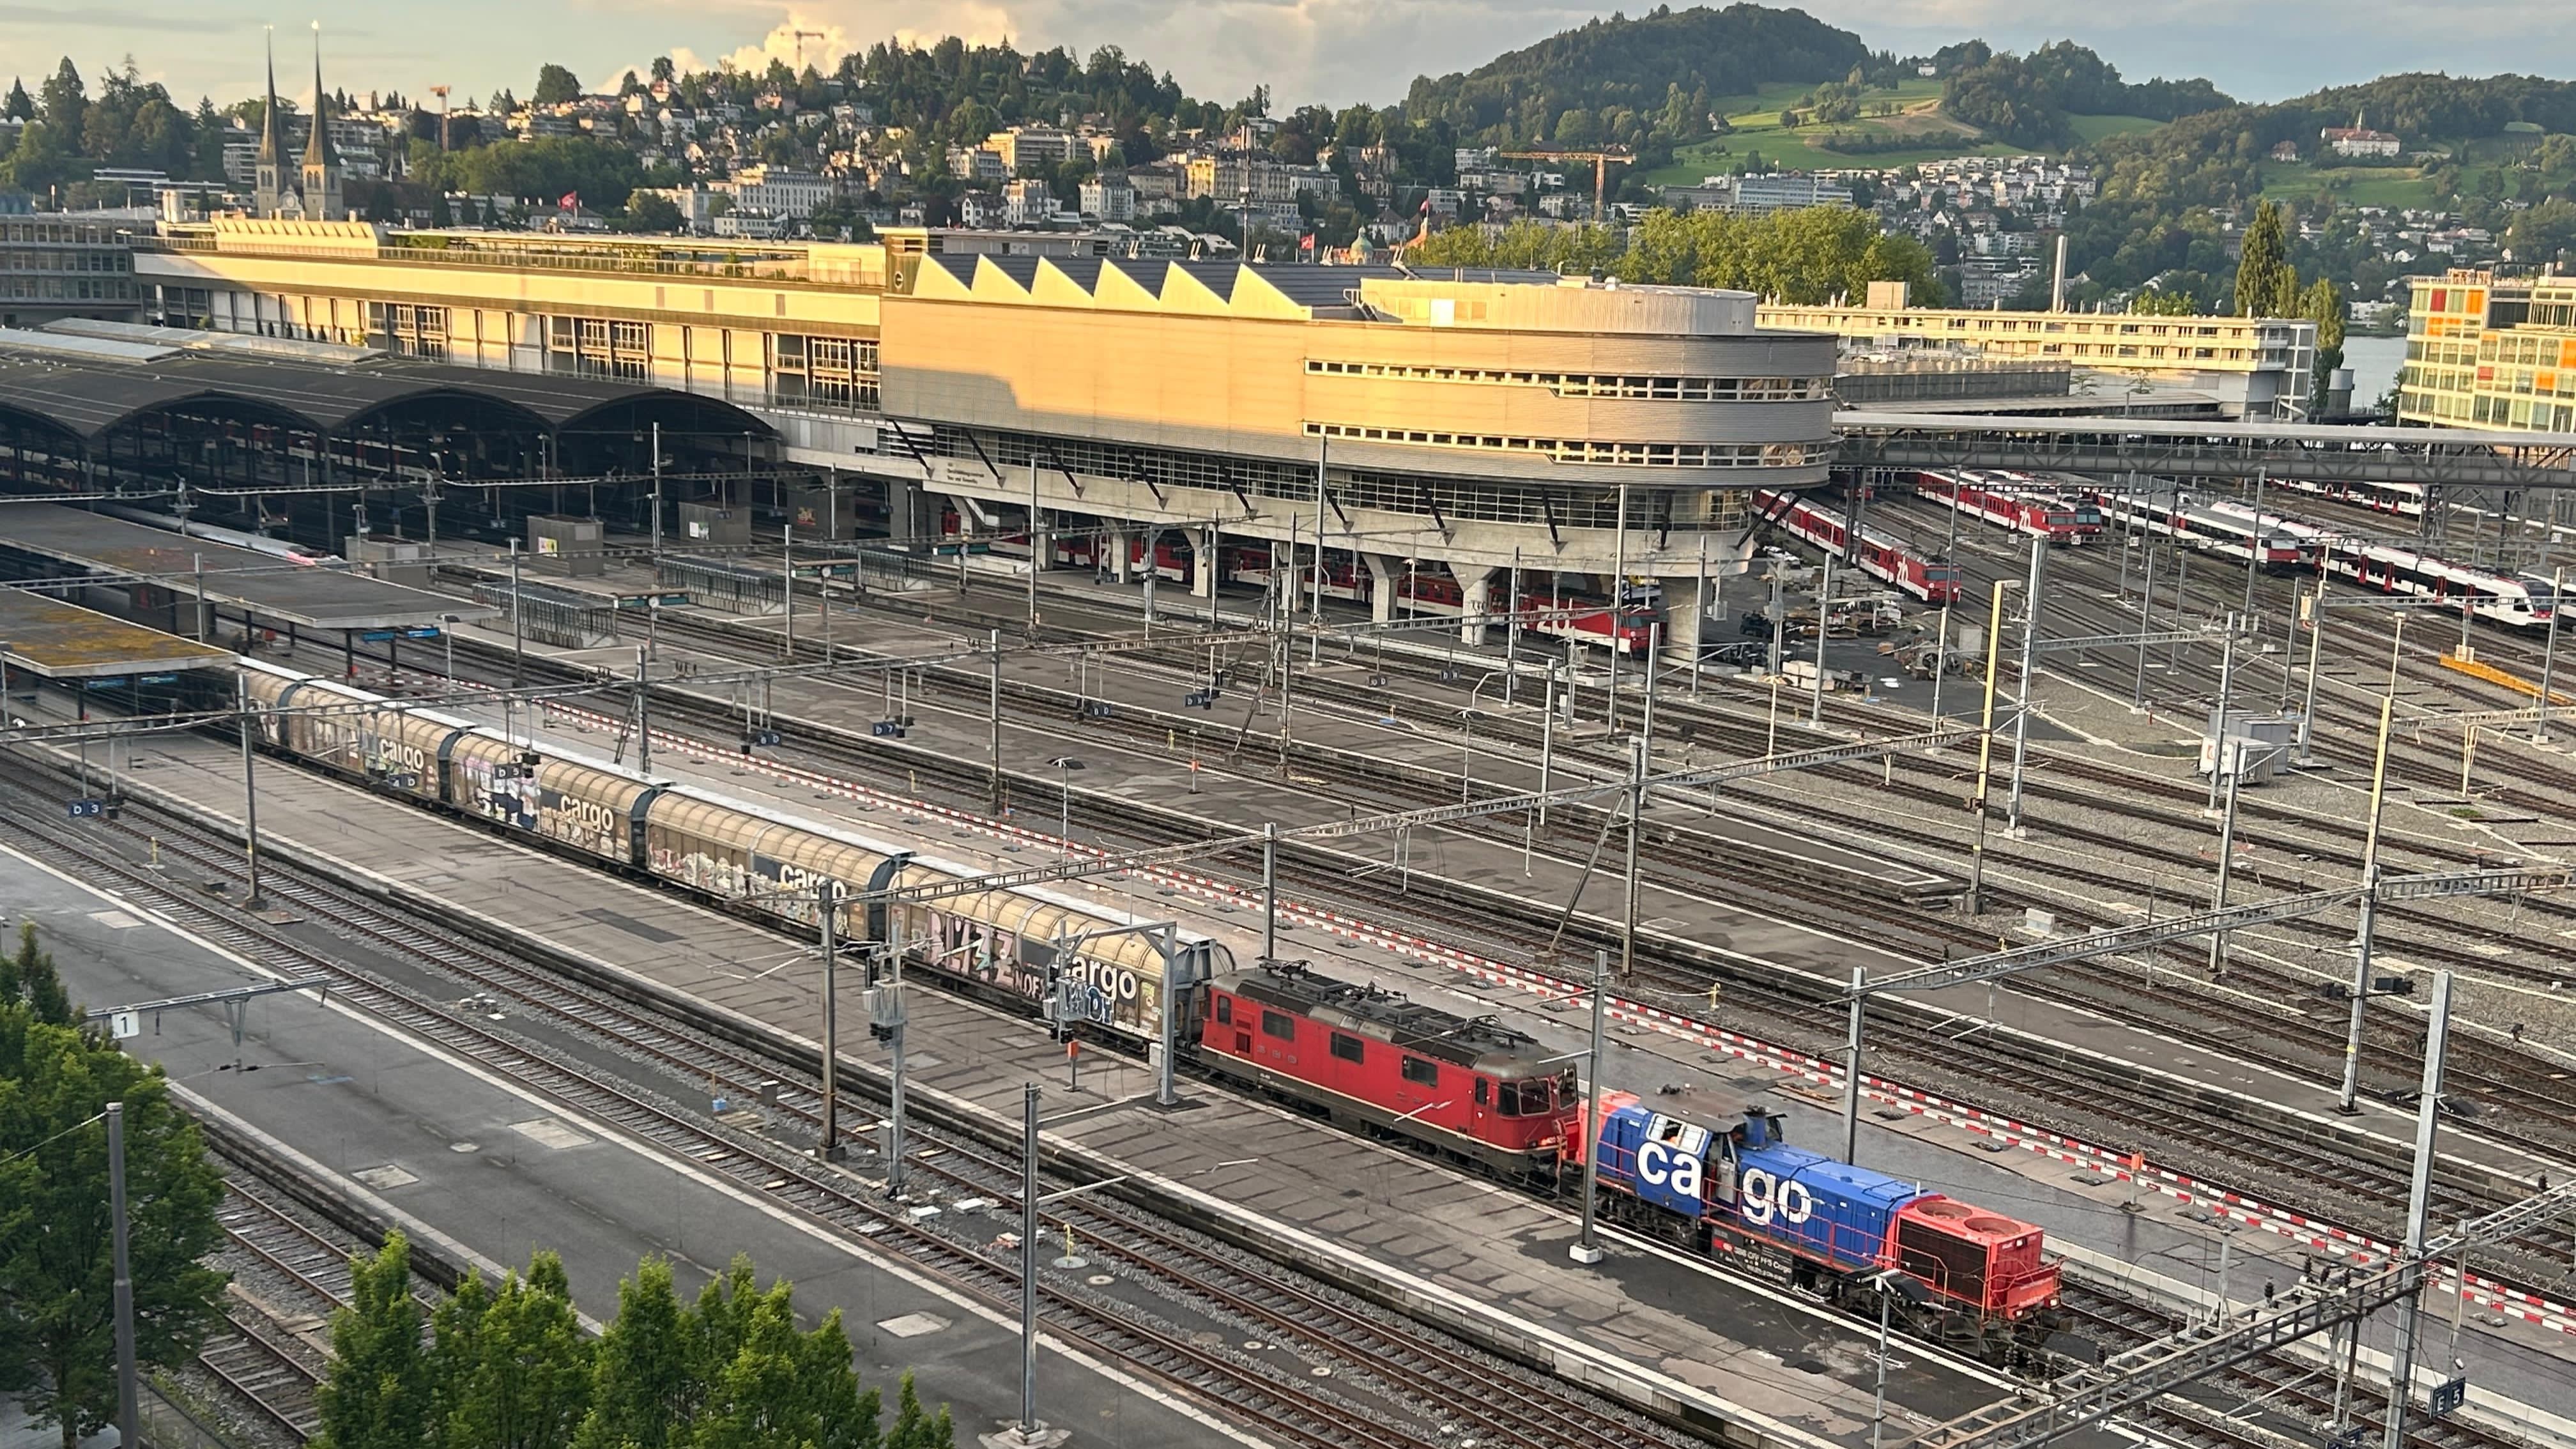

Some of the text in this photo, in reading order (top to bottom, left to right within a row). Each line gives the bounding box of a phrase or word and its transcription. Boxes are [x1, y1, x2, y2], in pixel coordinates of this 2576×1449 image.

[73, 804, 99, 815] D 3
[560, 794, 614, 832] cargo
[121, 1016, 128, 1034] 1
[2437, 1388, 2461, 1412] E 5
